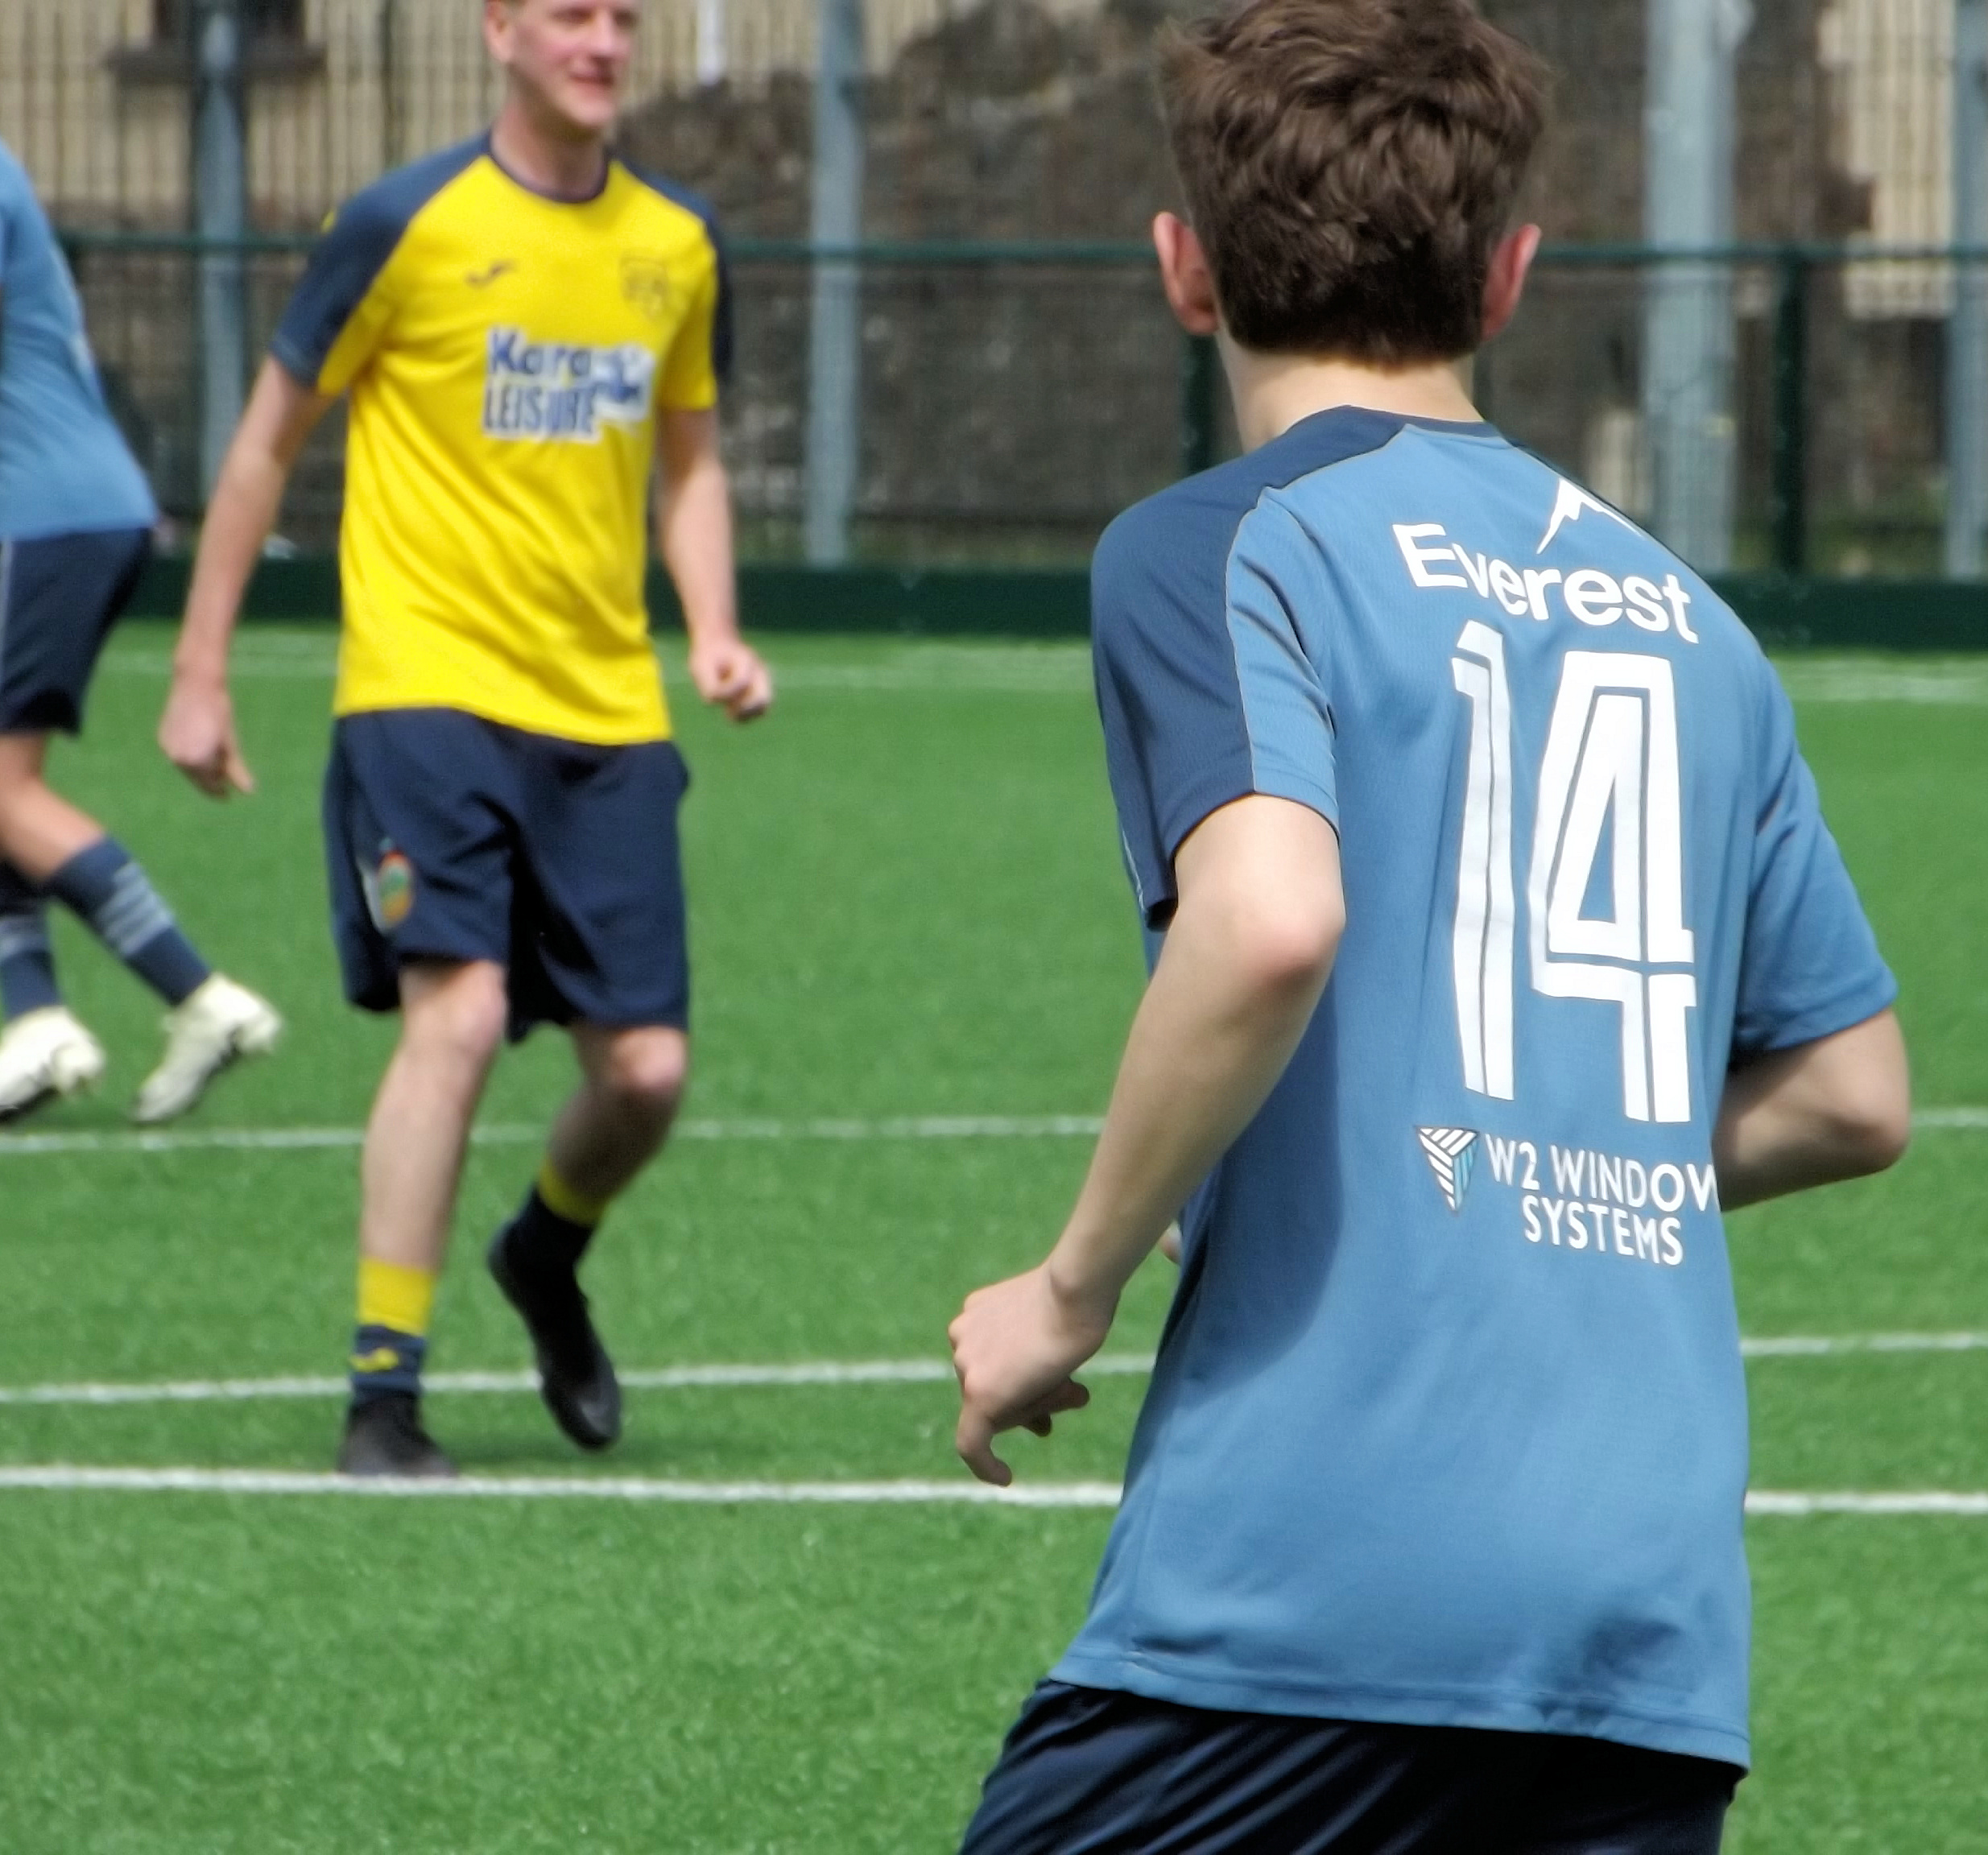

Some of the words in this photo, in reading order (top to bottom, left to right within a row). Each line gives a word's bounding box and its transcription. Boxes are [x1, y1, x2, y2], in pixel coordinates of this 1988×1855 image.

[1392, 523, 1699, 643] Everest
[1452, 619, 1697, 1123] 14
[1486, 1134, 1540, 1191] W2
[1522, 1195, 1684, 1266] SYSTEMS
